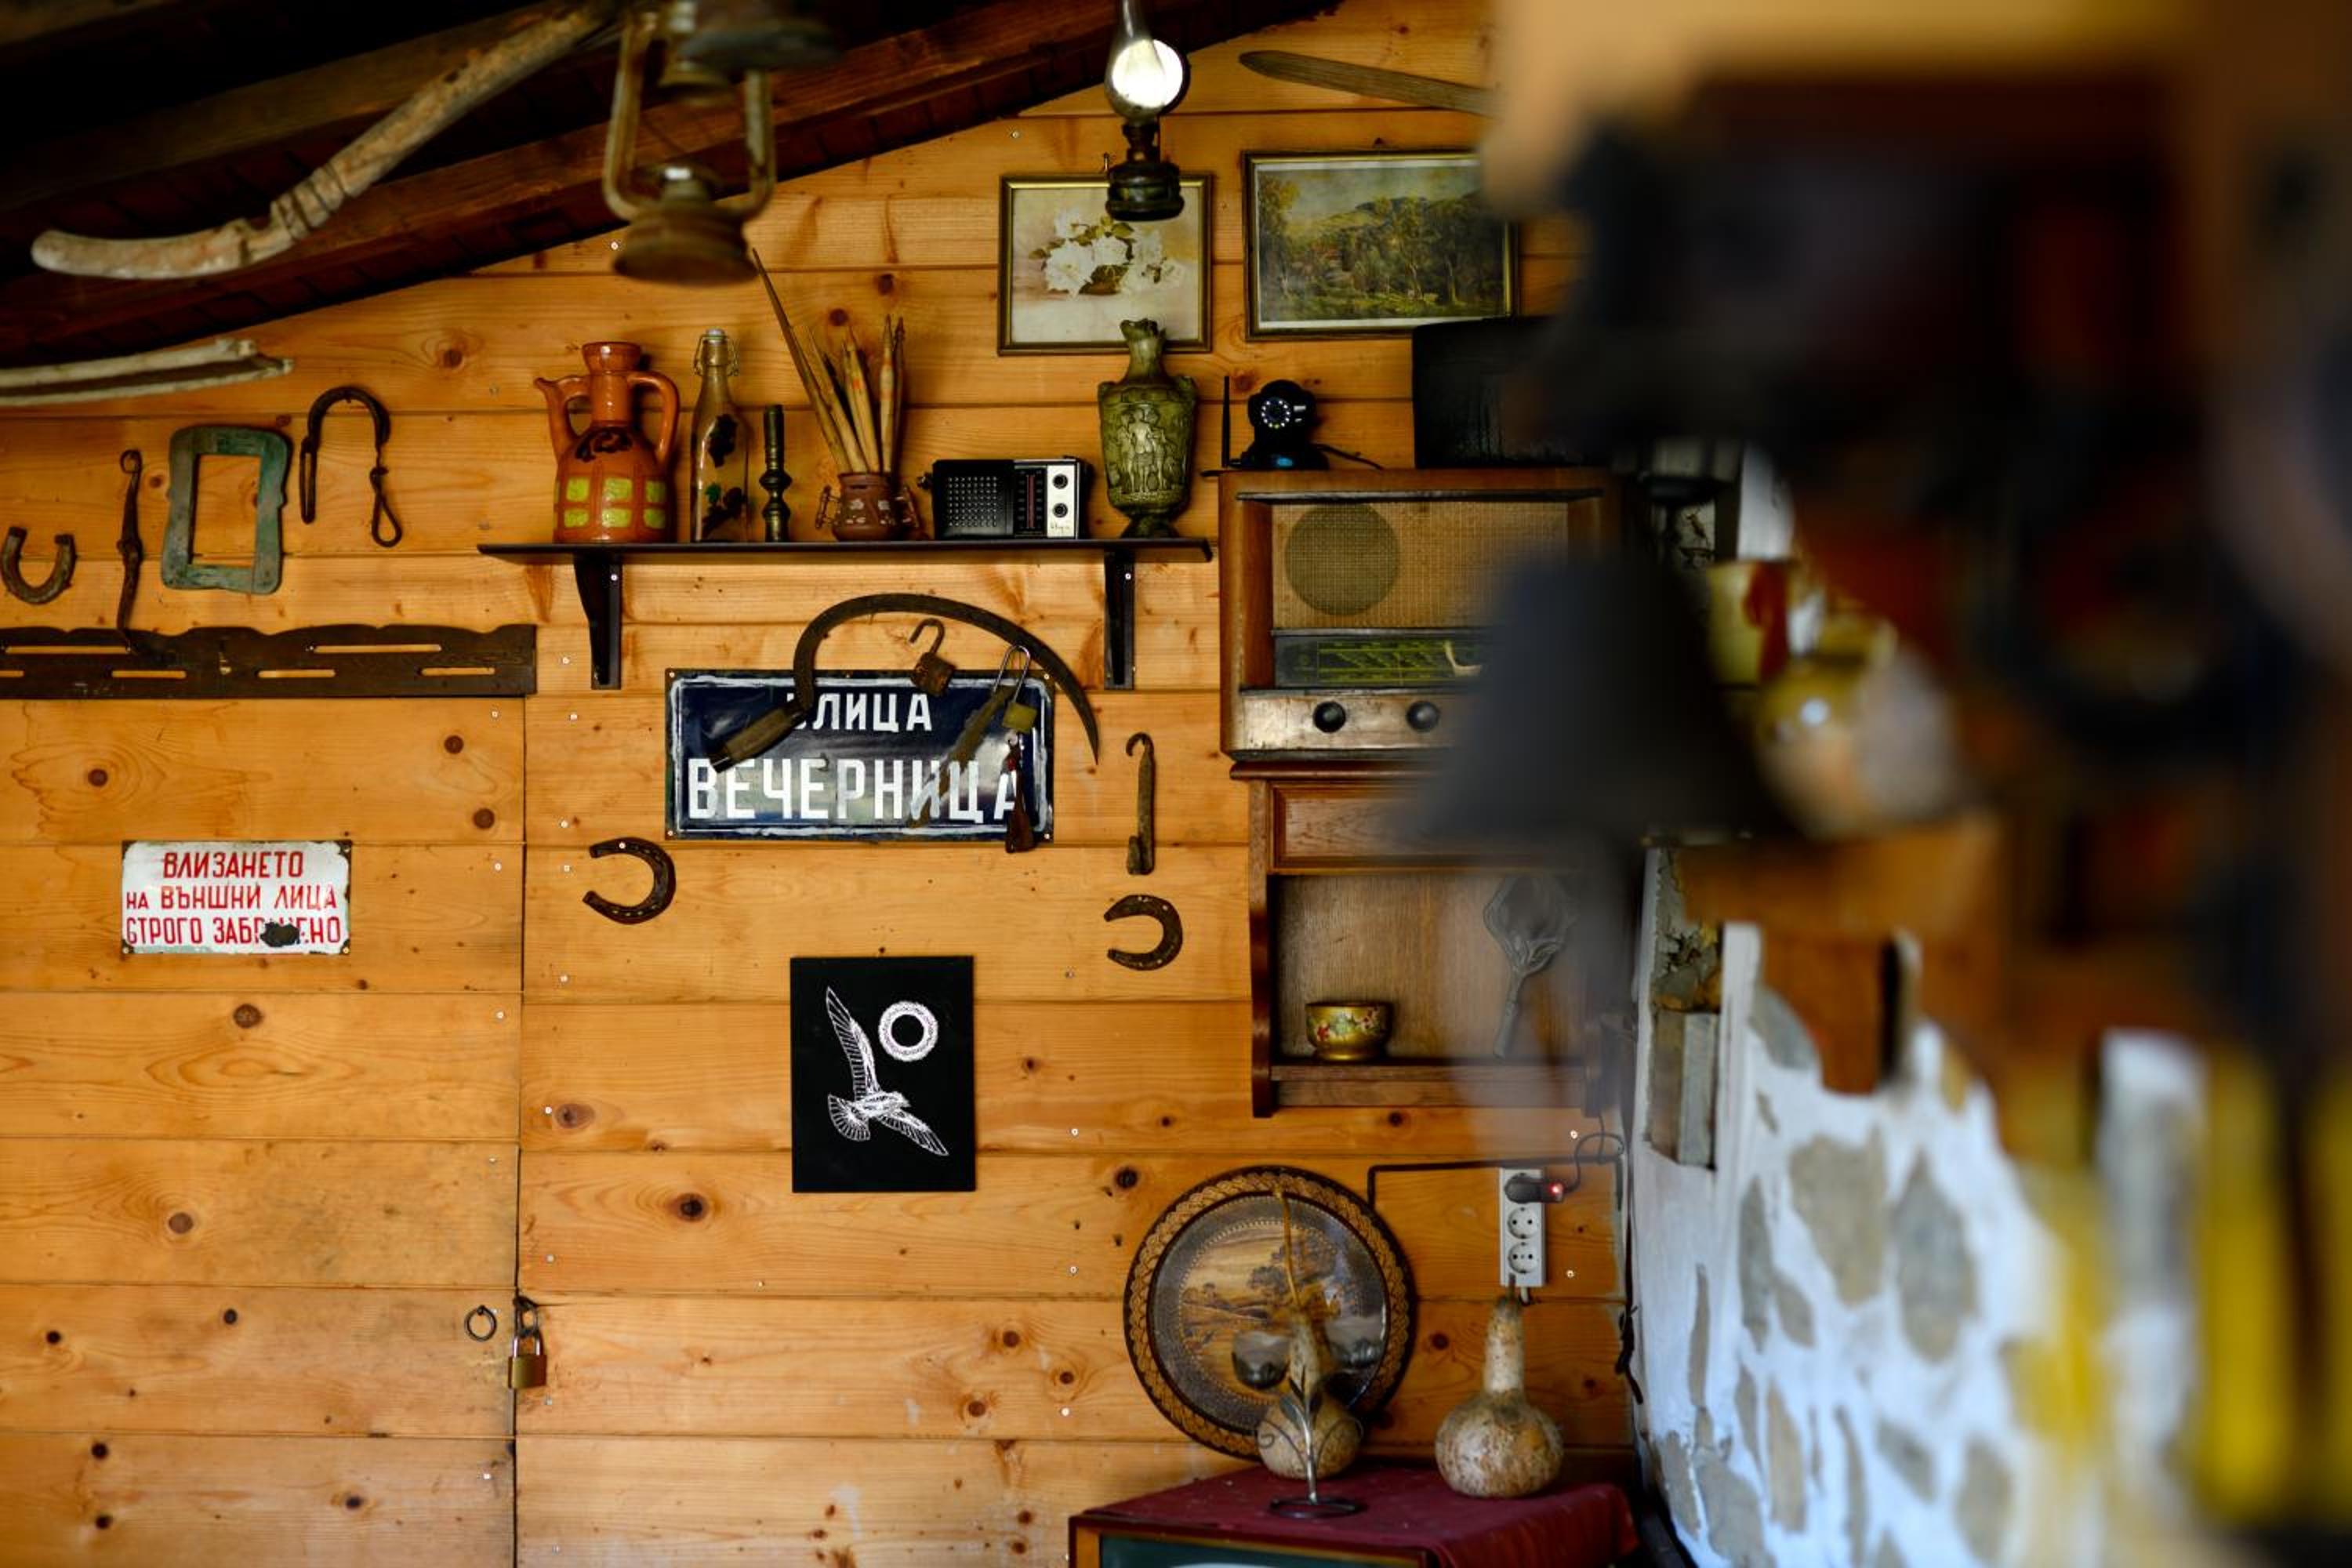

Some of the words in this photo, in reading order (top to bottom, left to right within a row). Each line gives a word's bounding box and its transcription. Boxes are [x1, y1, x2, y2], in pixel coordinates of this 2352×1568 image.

[786, 693, 932, 732] ЛИЦА
[162, 851, 304, 879] ВЛИЗАНЕТО
[126, 891, 149, 909] НА
[161, 885, 261, 909] ВЪНШНИ
[274, 884, 338, 911] ЛИЦА
[212, 916, 341, 945] ЗАБРЕНО
